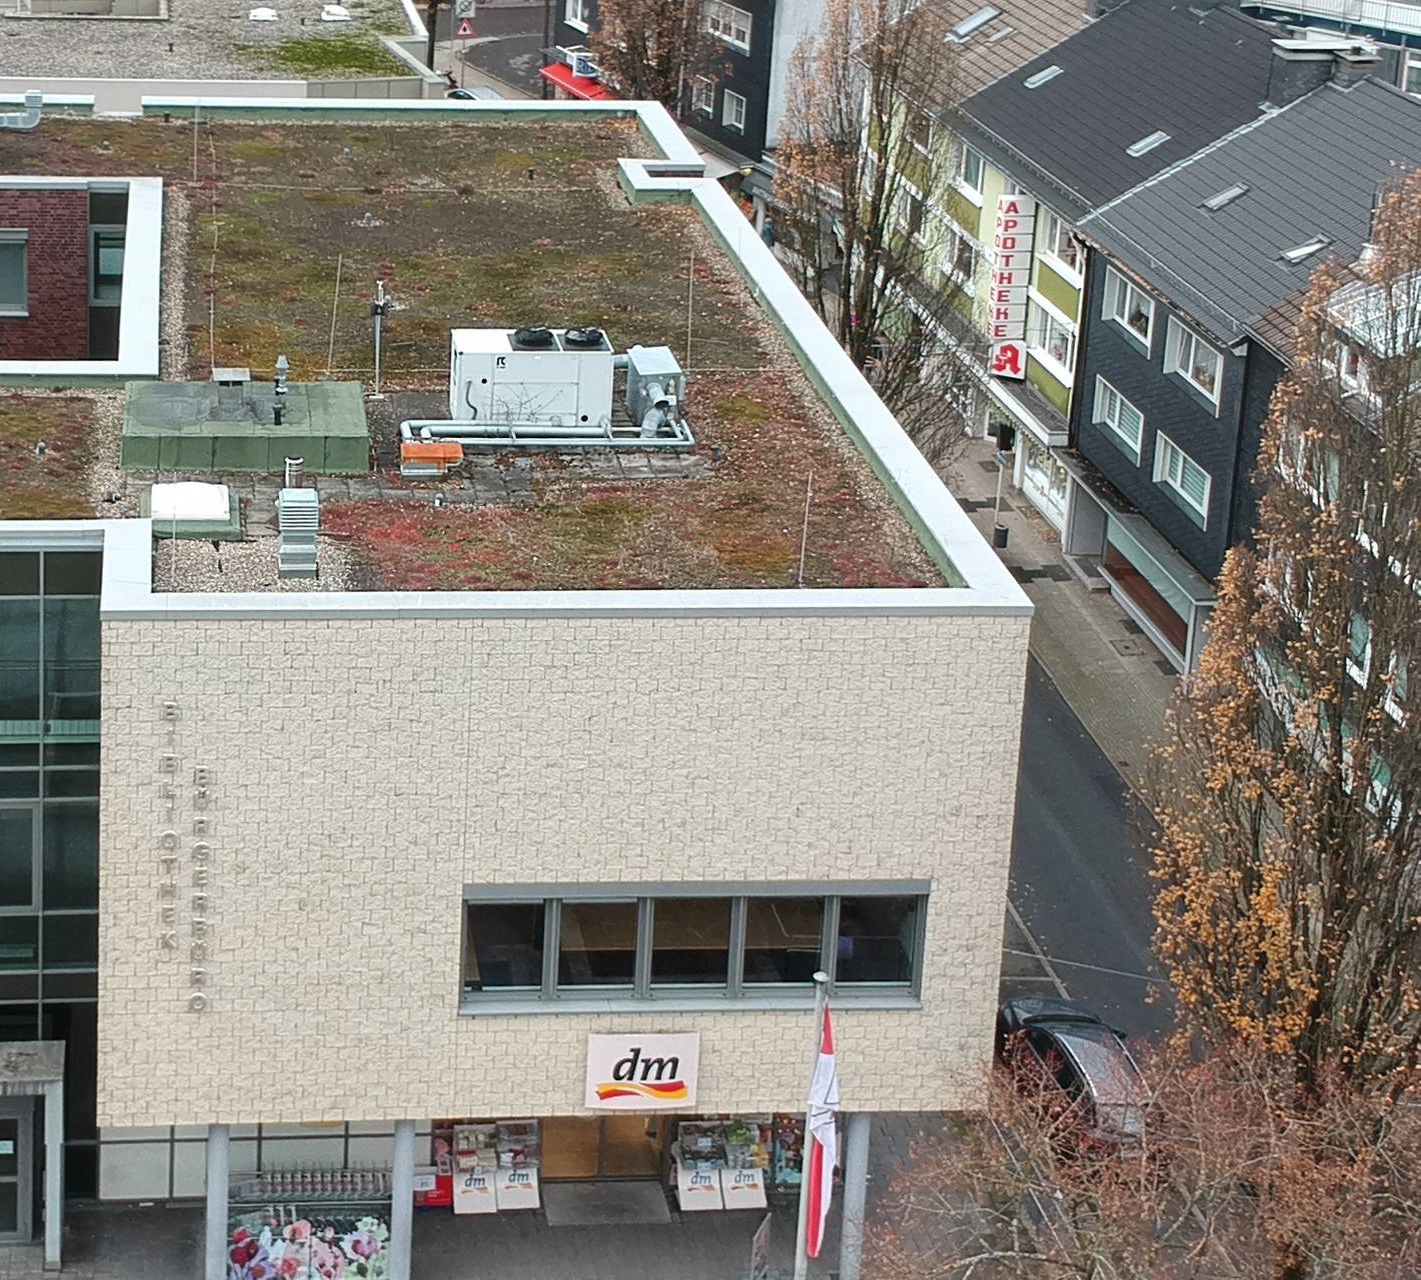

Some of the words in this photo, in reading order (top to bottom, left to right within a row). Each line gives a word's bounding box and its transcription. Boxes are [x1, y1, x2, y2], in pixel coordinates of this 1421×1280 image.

[994, 201, 1019, 337] APOTHEKE
[161, 701, 178, 949] BIBLIOTHEK
[190, 765, 210, 1011] BÜRGERBÜRO
[612, 1047, 680, 1081] dm
[465, 1174, 486, 1188] dm
[507, 1169, 529, 1182] dm
[690, 1171, 712, 1184] dm
[734, 1170, 755, 1183] dm
